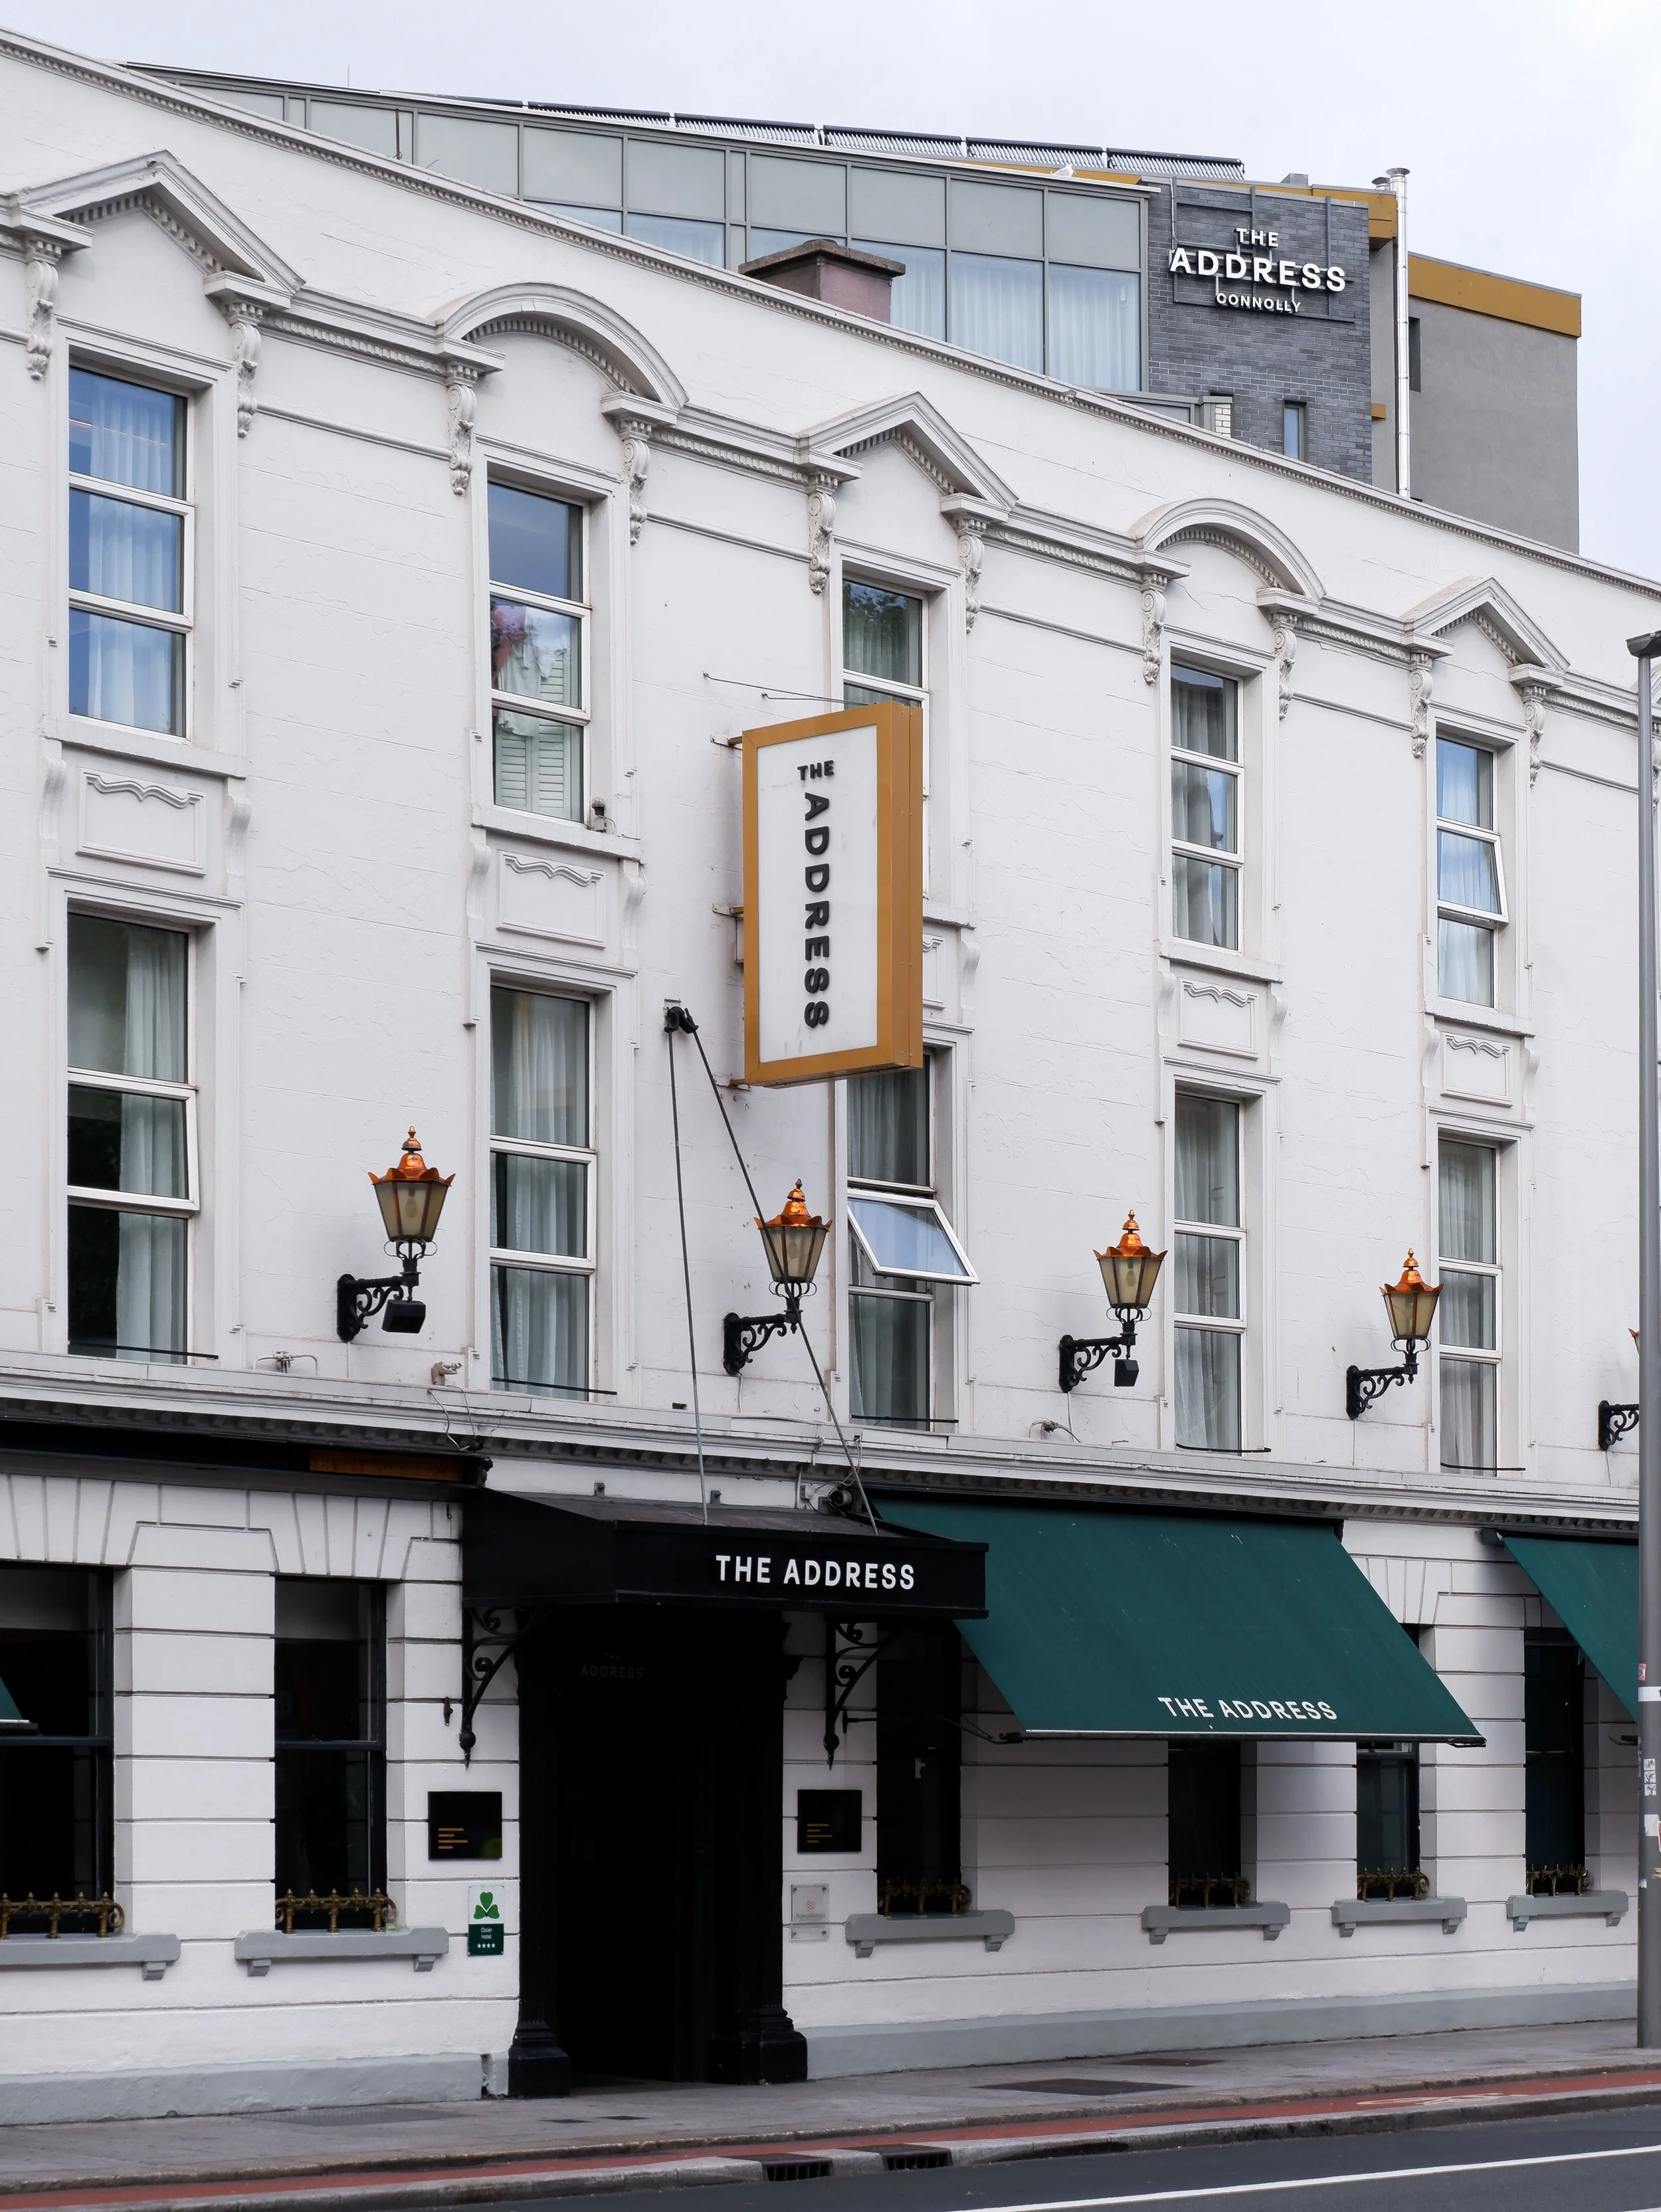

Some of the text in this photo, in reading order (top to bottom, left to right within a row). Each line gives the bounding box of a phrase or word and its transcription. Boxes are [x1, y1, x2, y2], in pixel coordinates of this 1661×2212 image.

[1235, 227, 1279, 248] THE
[1170, 247, 1346, 292] ADDRESS
[1216, 292, 1301, 313] CONNOLLY
[797, 760, 834, 781] THE
[804, 792, 830, 1029] ADDRESS
[716, 1554, 915, 1590] THE ADDRESS
[580, 1665, 643, 1679] ADDRESS
[1157, 1697, 1337, 1720] THE ADDRESS
